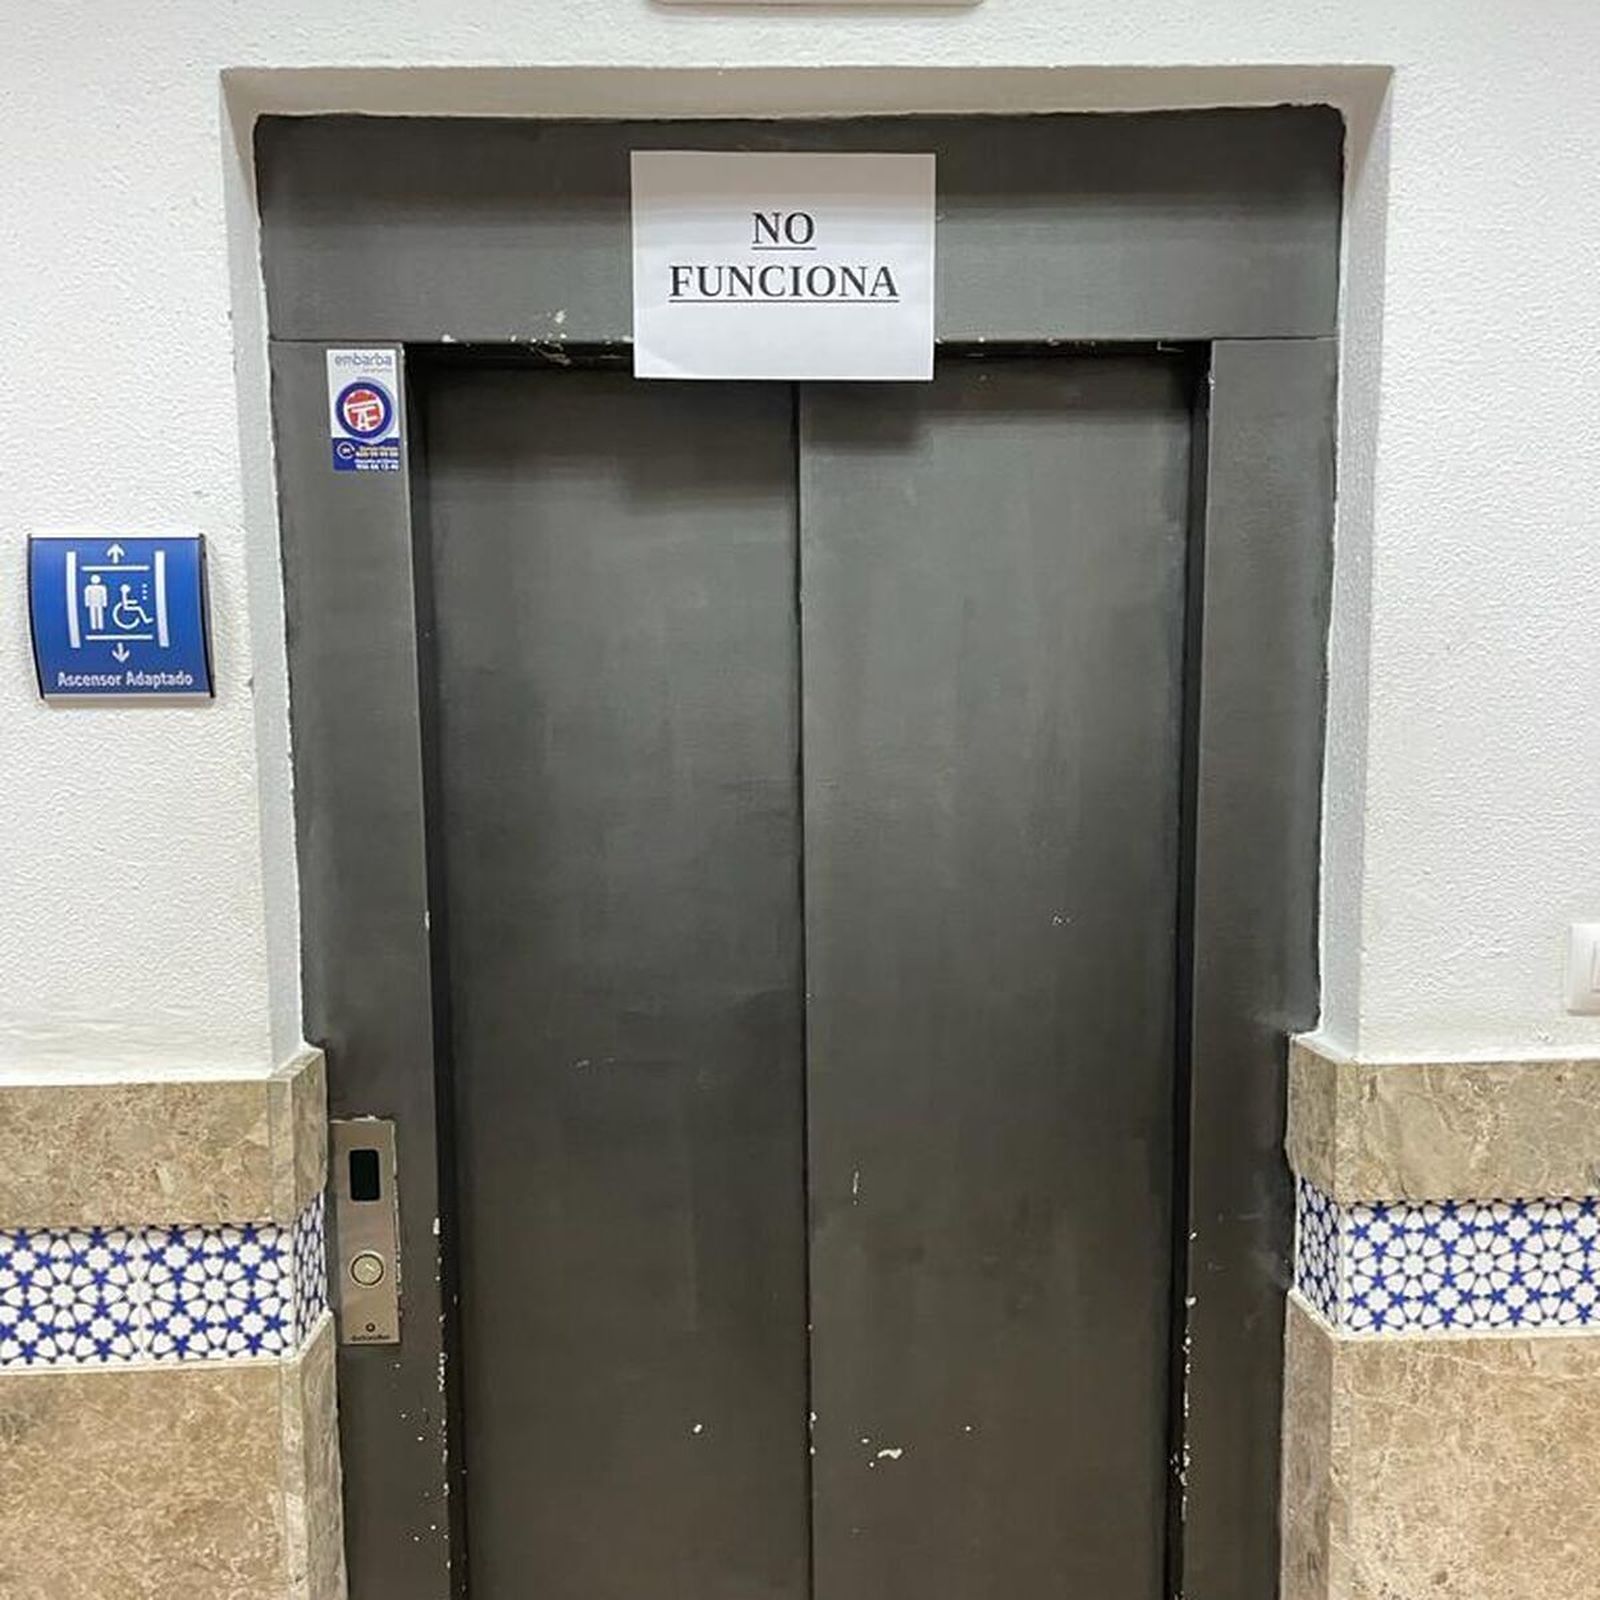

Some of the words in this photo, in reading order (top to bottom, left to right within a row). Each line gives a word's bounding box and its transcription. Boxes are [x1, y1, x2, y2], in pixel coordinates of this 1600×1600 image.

[752, 211, 816, 246] NO
[668, 264, 900, 298] FUNCIONA
[334, 352, 393, 366] embarba
[57, 671, 121, 687] Ascensor
[126, 670, 193, 689] Adaptado
